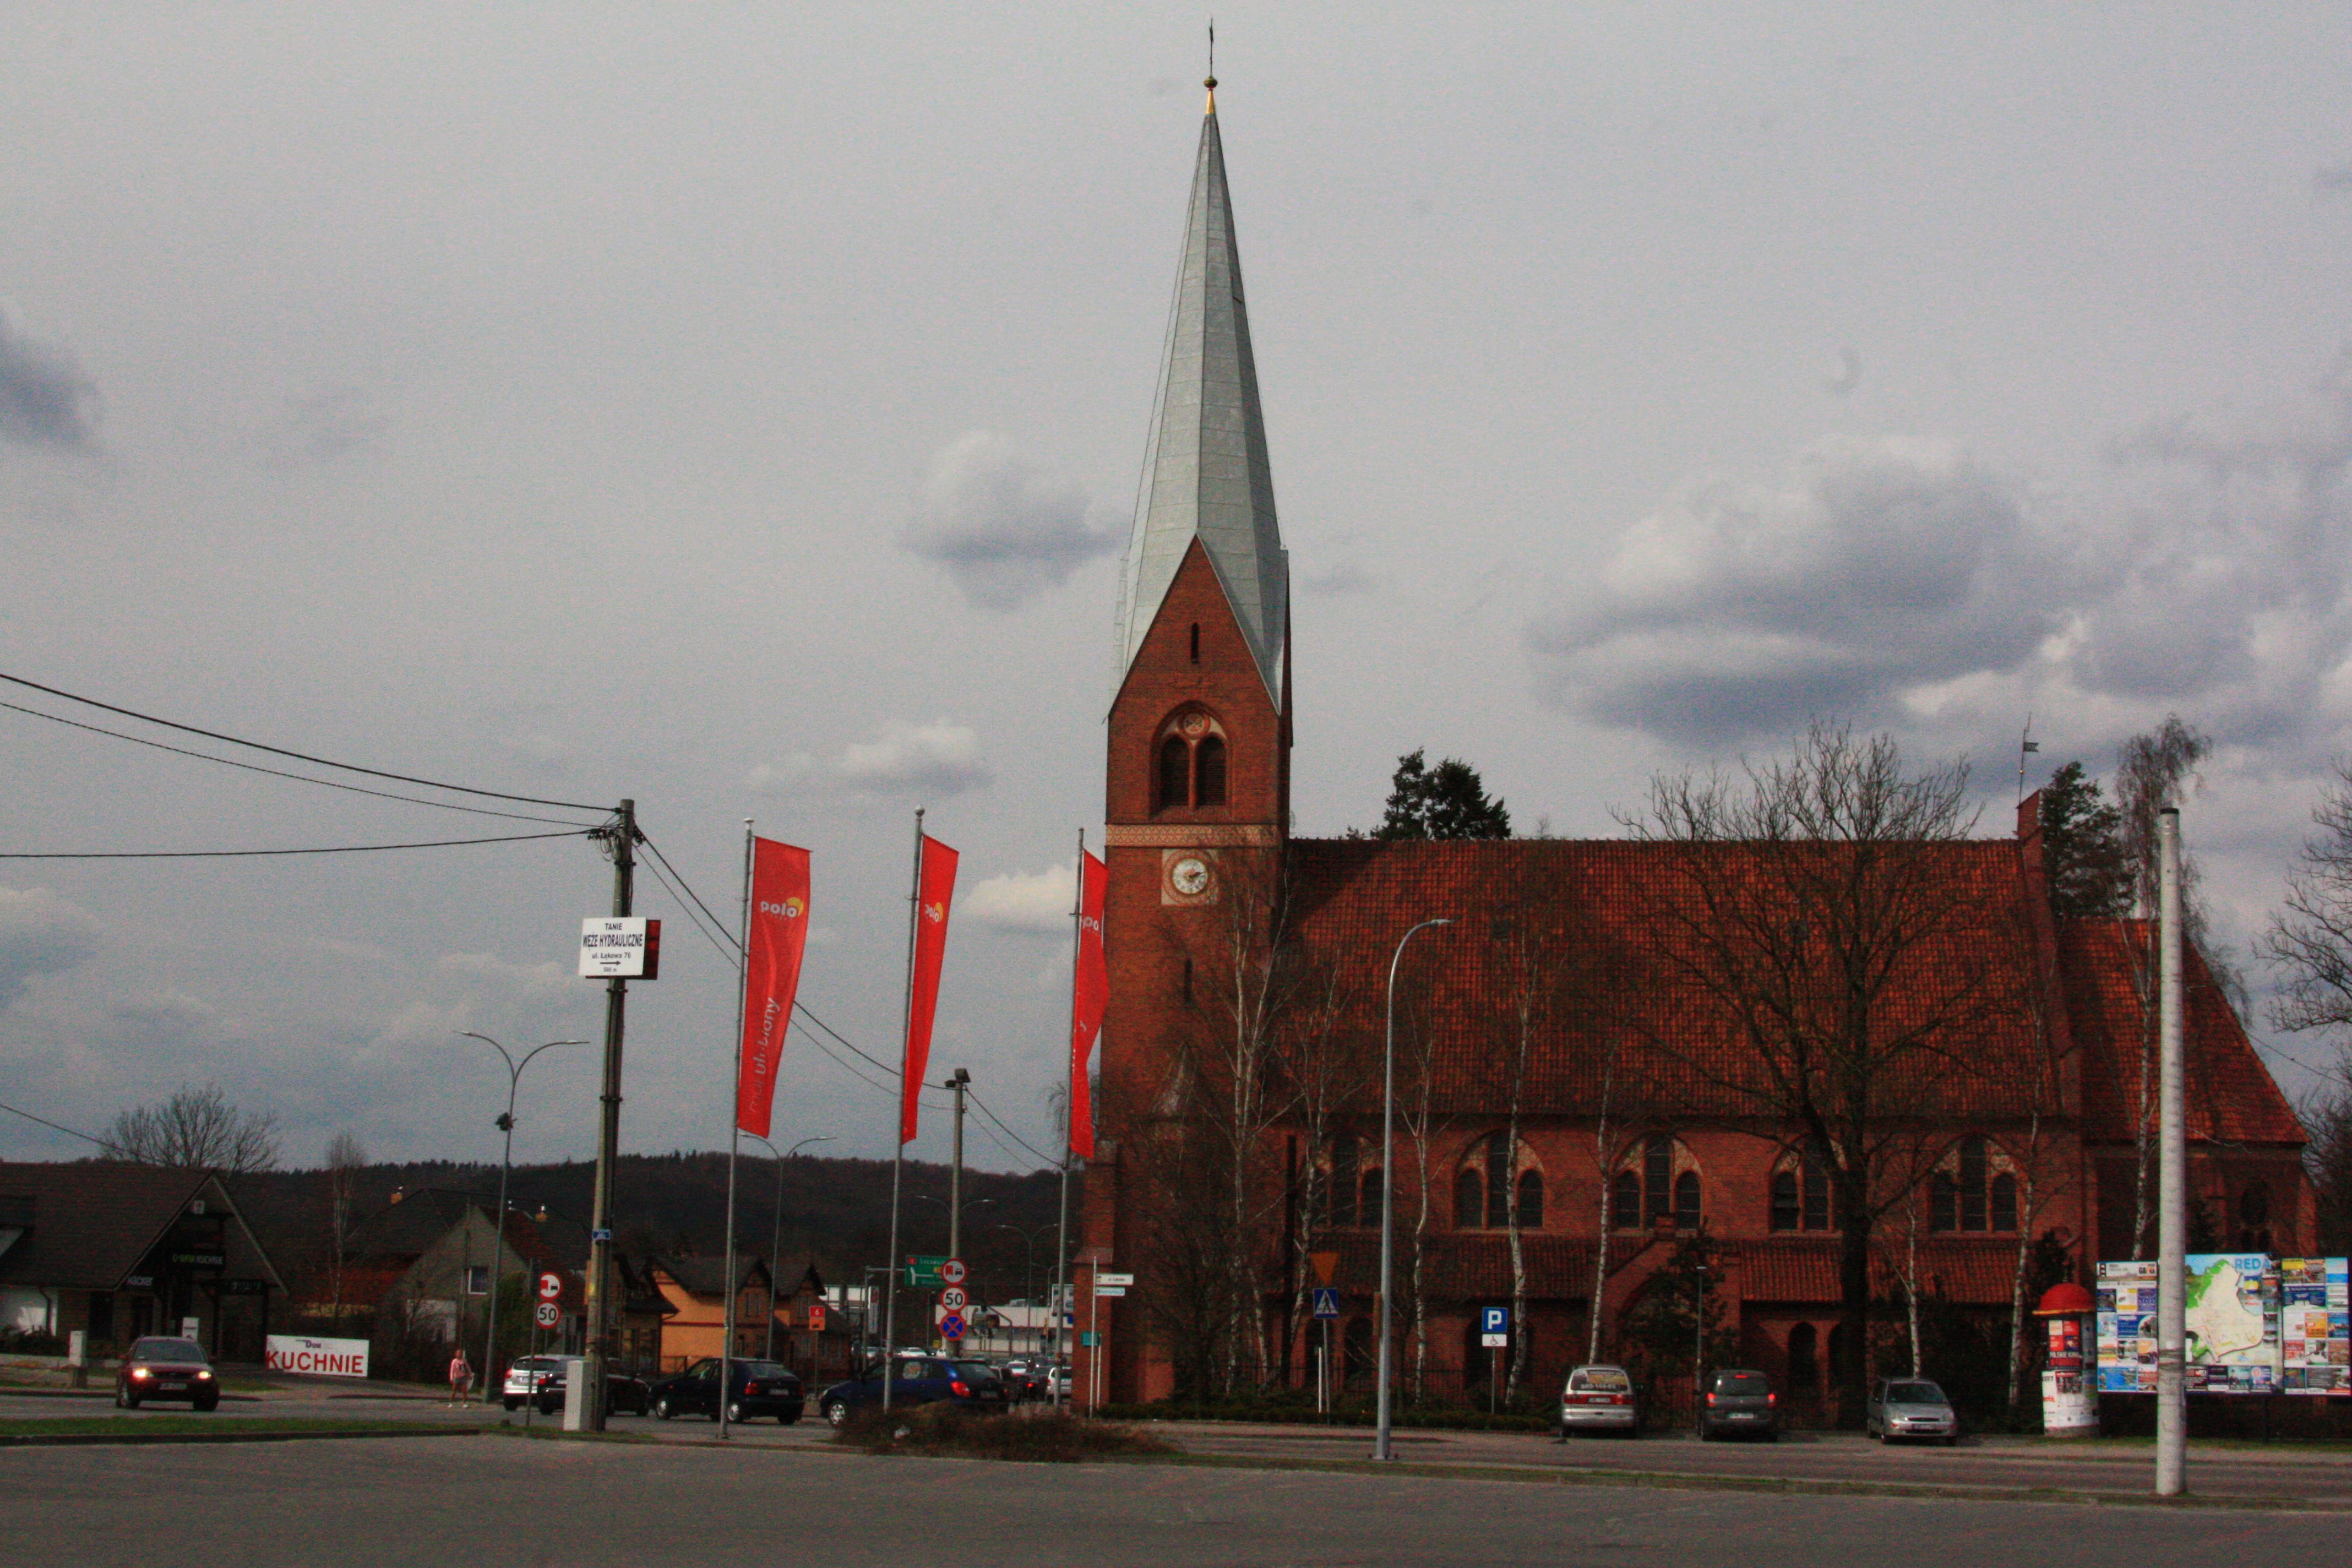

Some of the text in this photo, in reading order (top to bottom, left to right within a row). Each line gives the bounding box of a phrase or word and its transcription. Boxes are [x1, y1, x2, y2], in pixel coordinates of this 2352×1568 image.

[760, 900, 798, 918] polo
[599, 934, 643, 947] HYDRAULICZNE
[945, 1292, 963, 1306] 50
[539, 1307, 557, 1321] 50
[1488, 1310, 1502, 1330] P
[266, 1351, 364, 1374] KUCHNIE
